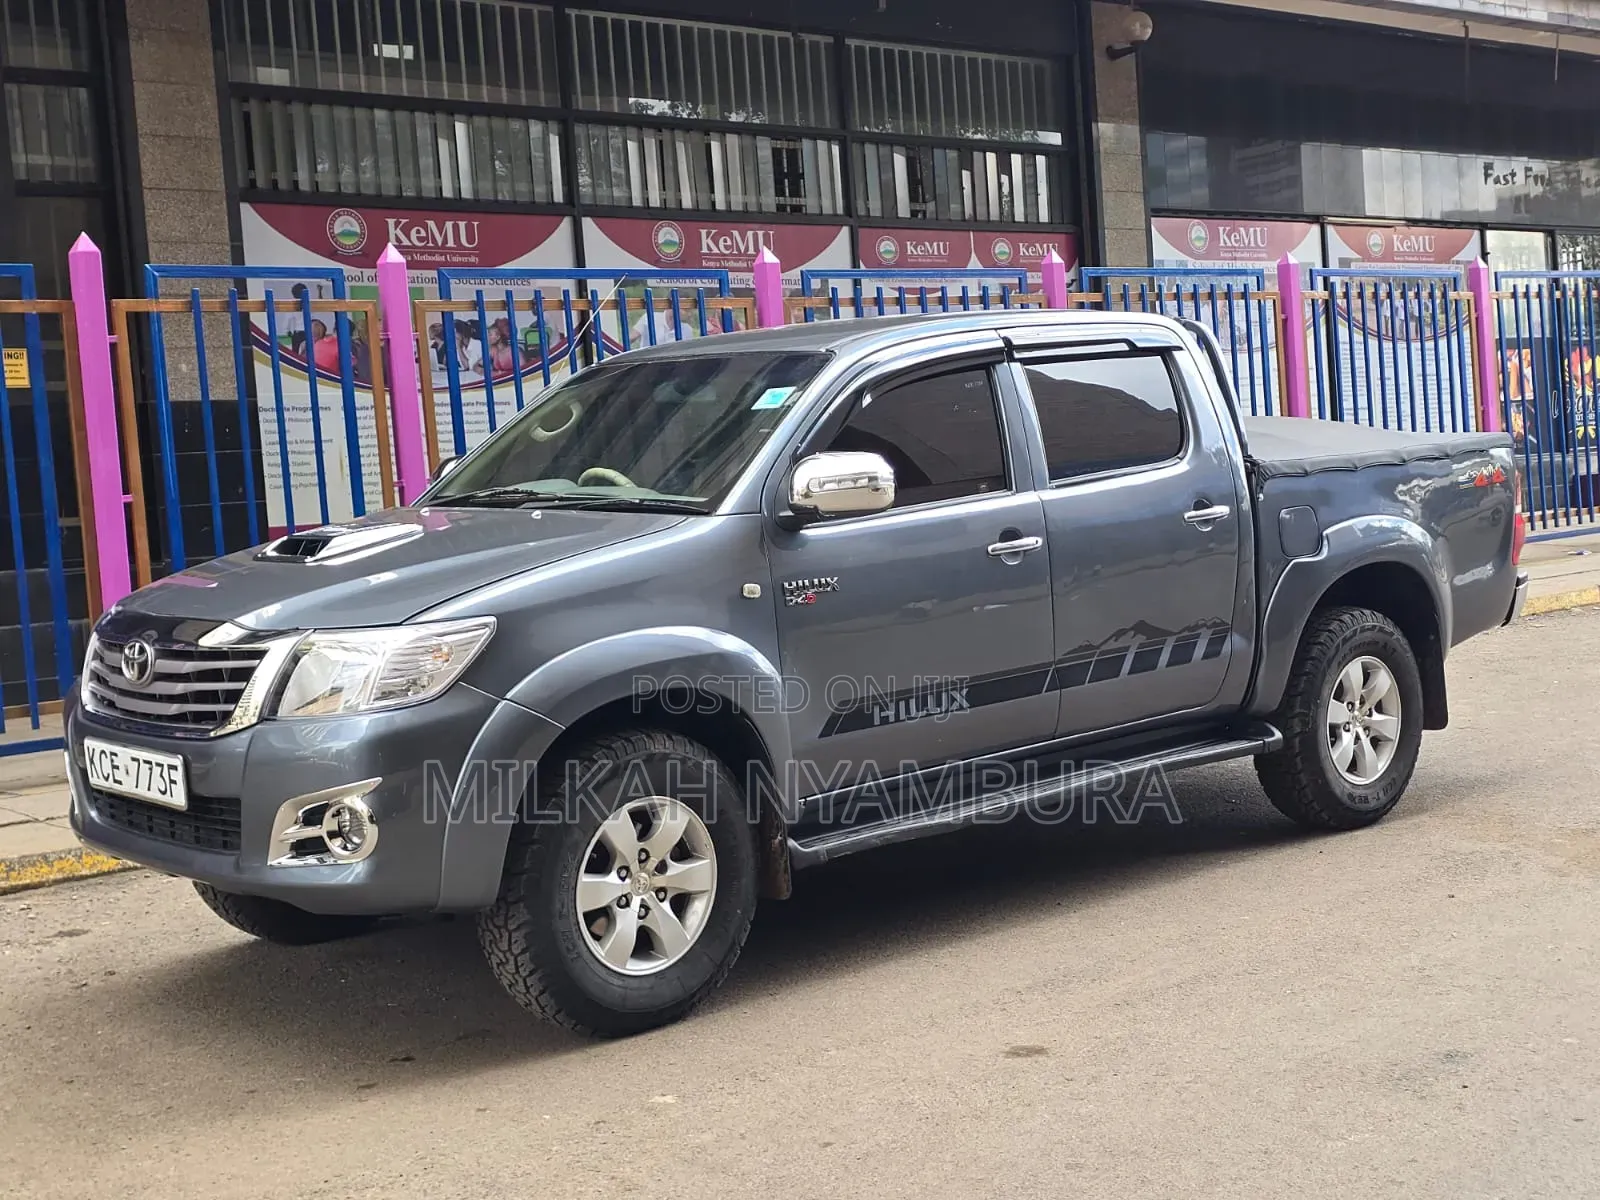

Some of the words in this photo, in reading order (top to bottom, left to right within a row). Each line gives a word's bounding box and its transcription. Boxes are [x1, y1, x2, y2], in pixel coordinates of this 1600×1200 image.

[1483, 161, 1517, 187] Fast
[385, 217, 480, 249] KeMU
[698, 228, 775, 255] KeMU
[1217, 226, 1268, 248] KeMU
[1392, 234, 1435, 253] KeMU
[413, 254, 445, 262] Methodist
[446, 255, 479, 264] University
[905, 241, 950, 256] KeMU
[1018, 242, 1058, 257] KeMU
[873, 688, 970, 726] HILUX
